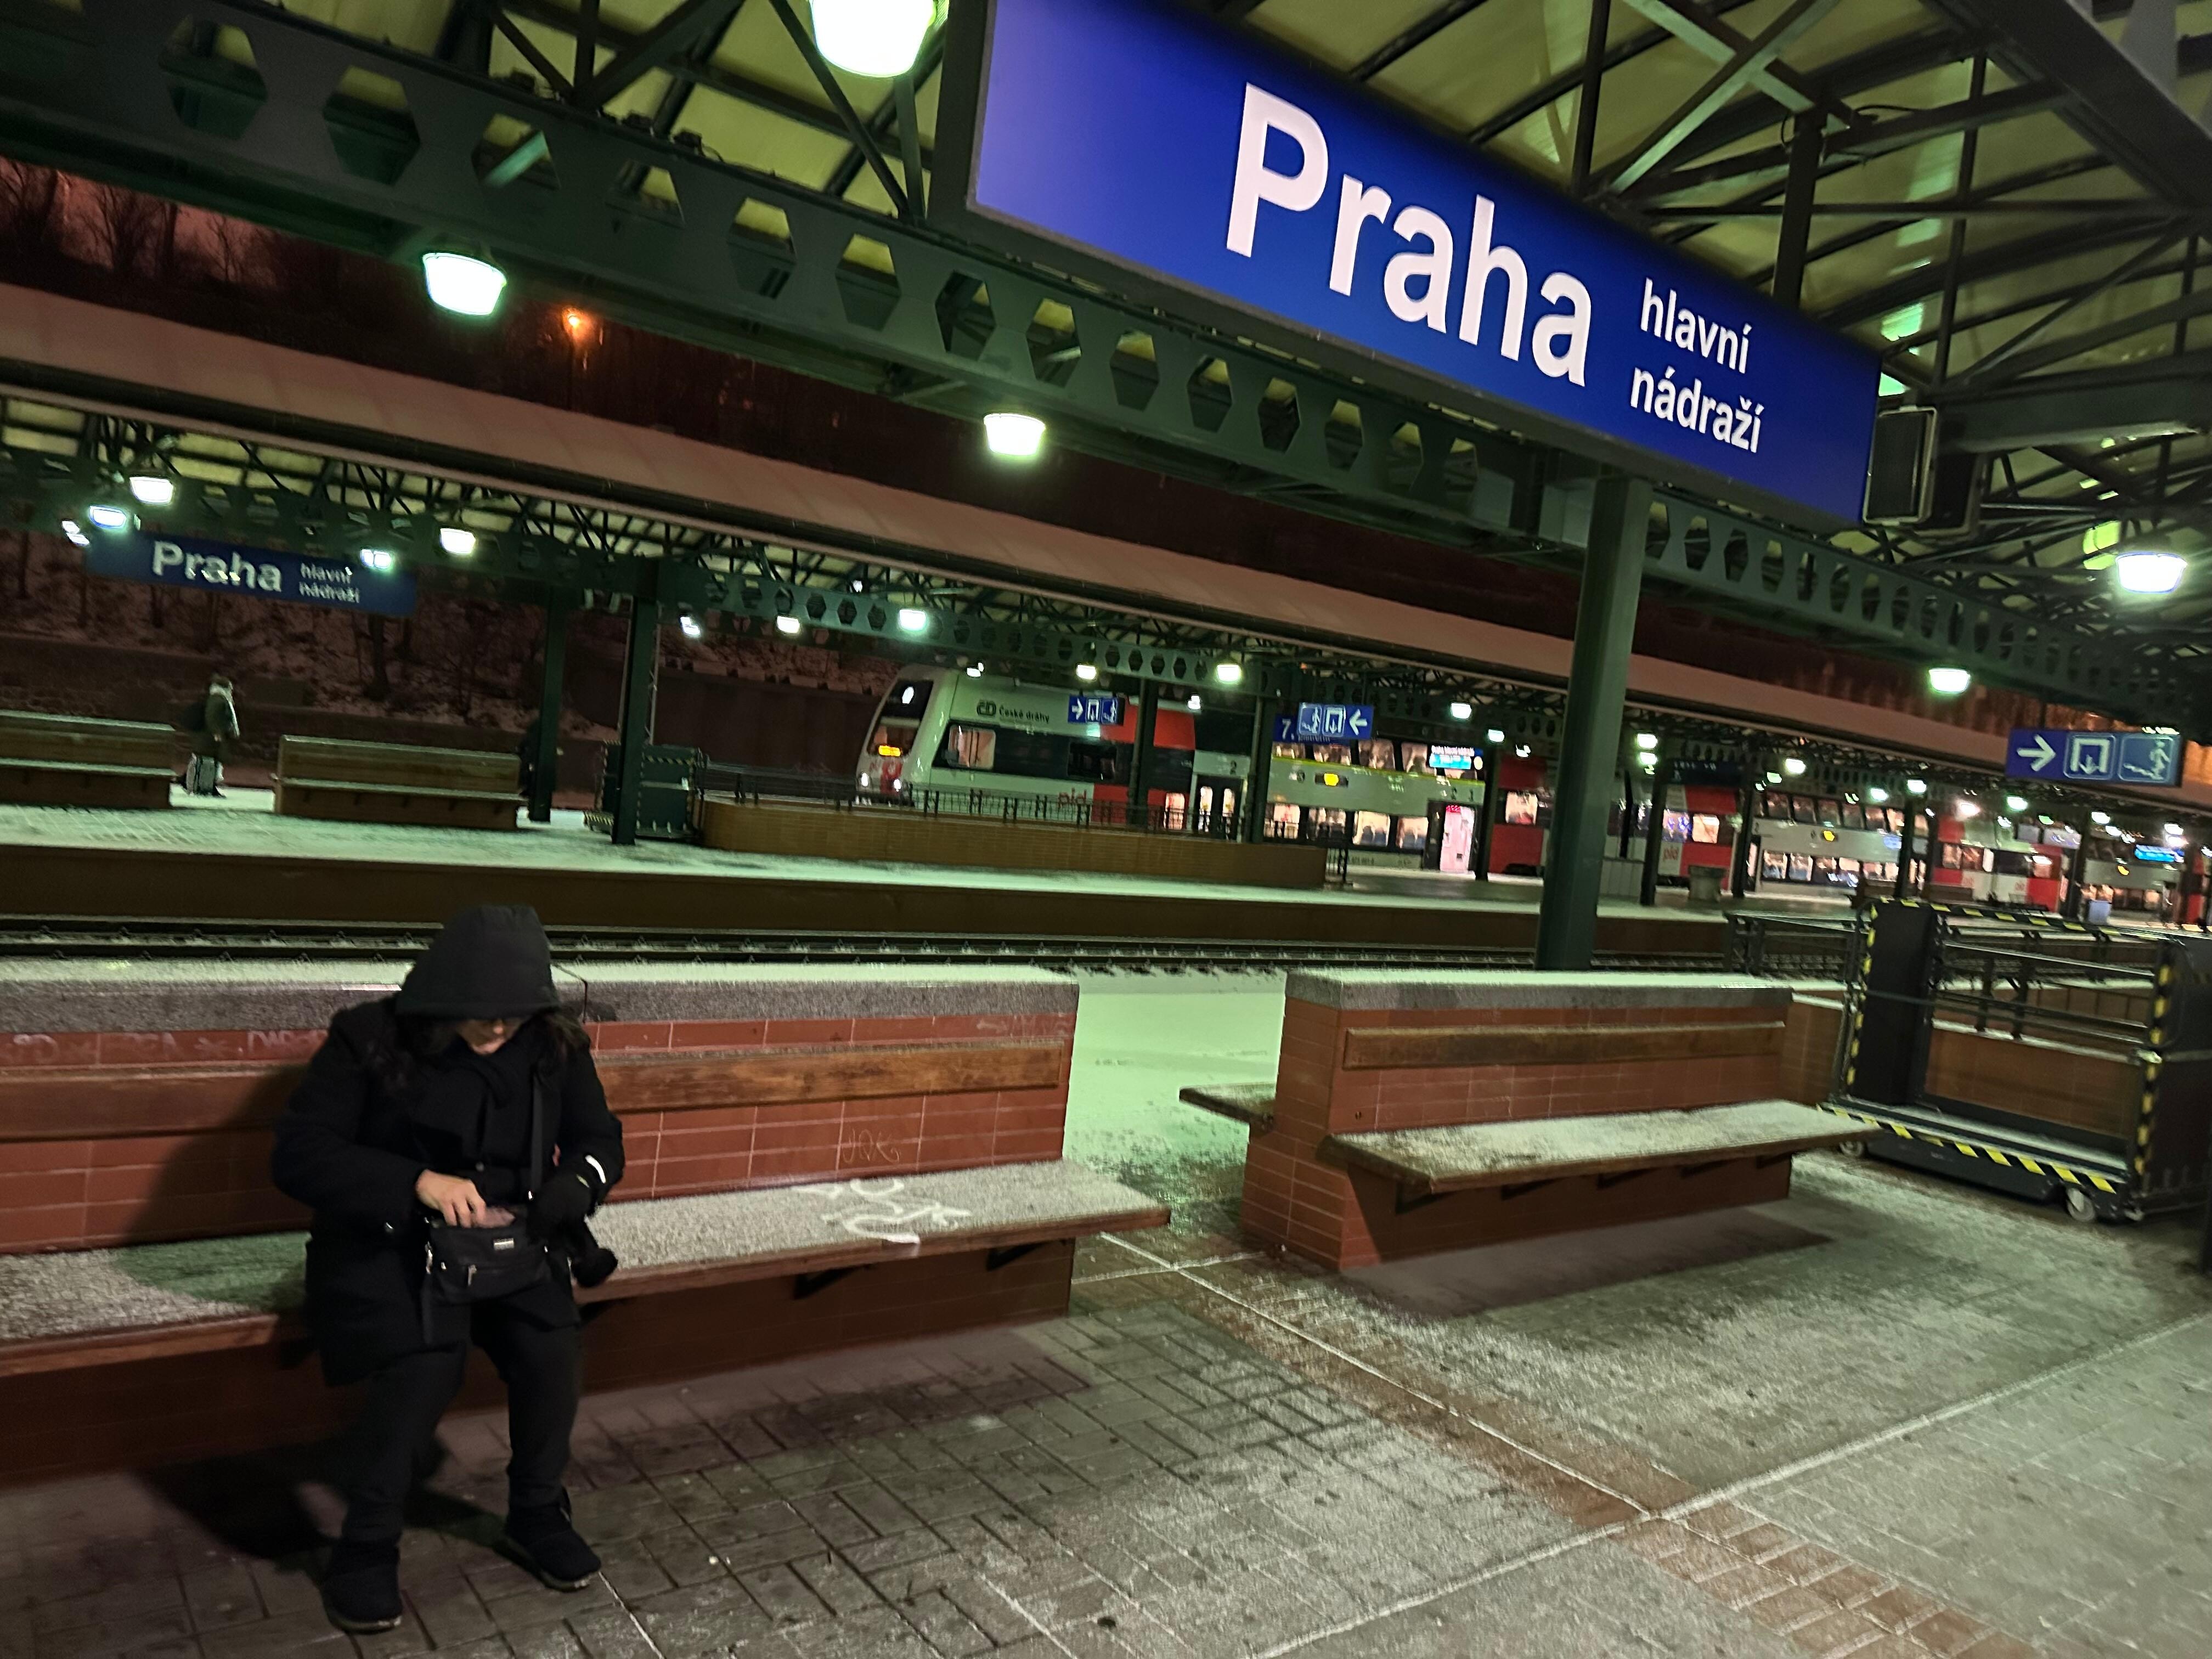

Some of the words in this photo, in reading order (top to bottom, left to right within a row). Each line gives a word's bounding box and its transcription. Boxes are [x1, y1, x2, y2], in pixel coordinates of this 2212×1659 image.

[1226, 82, 1593, 387] Praha
[1639, 277, 1753, 374] hlavní
[1630, 366, 1764, 454] nádraží
[152, 540, 281, 592] Praha
